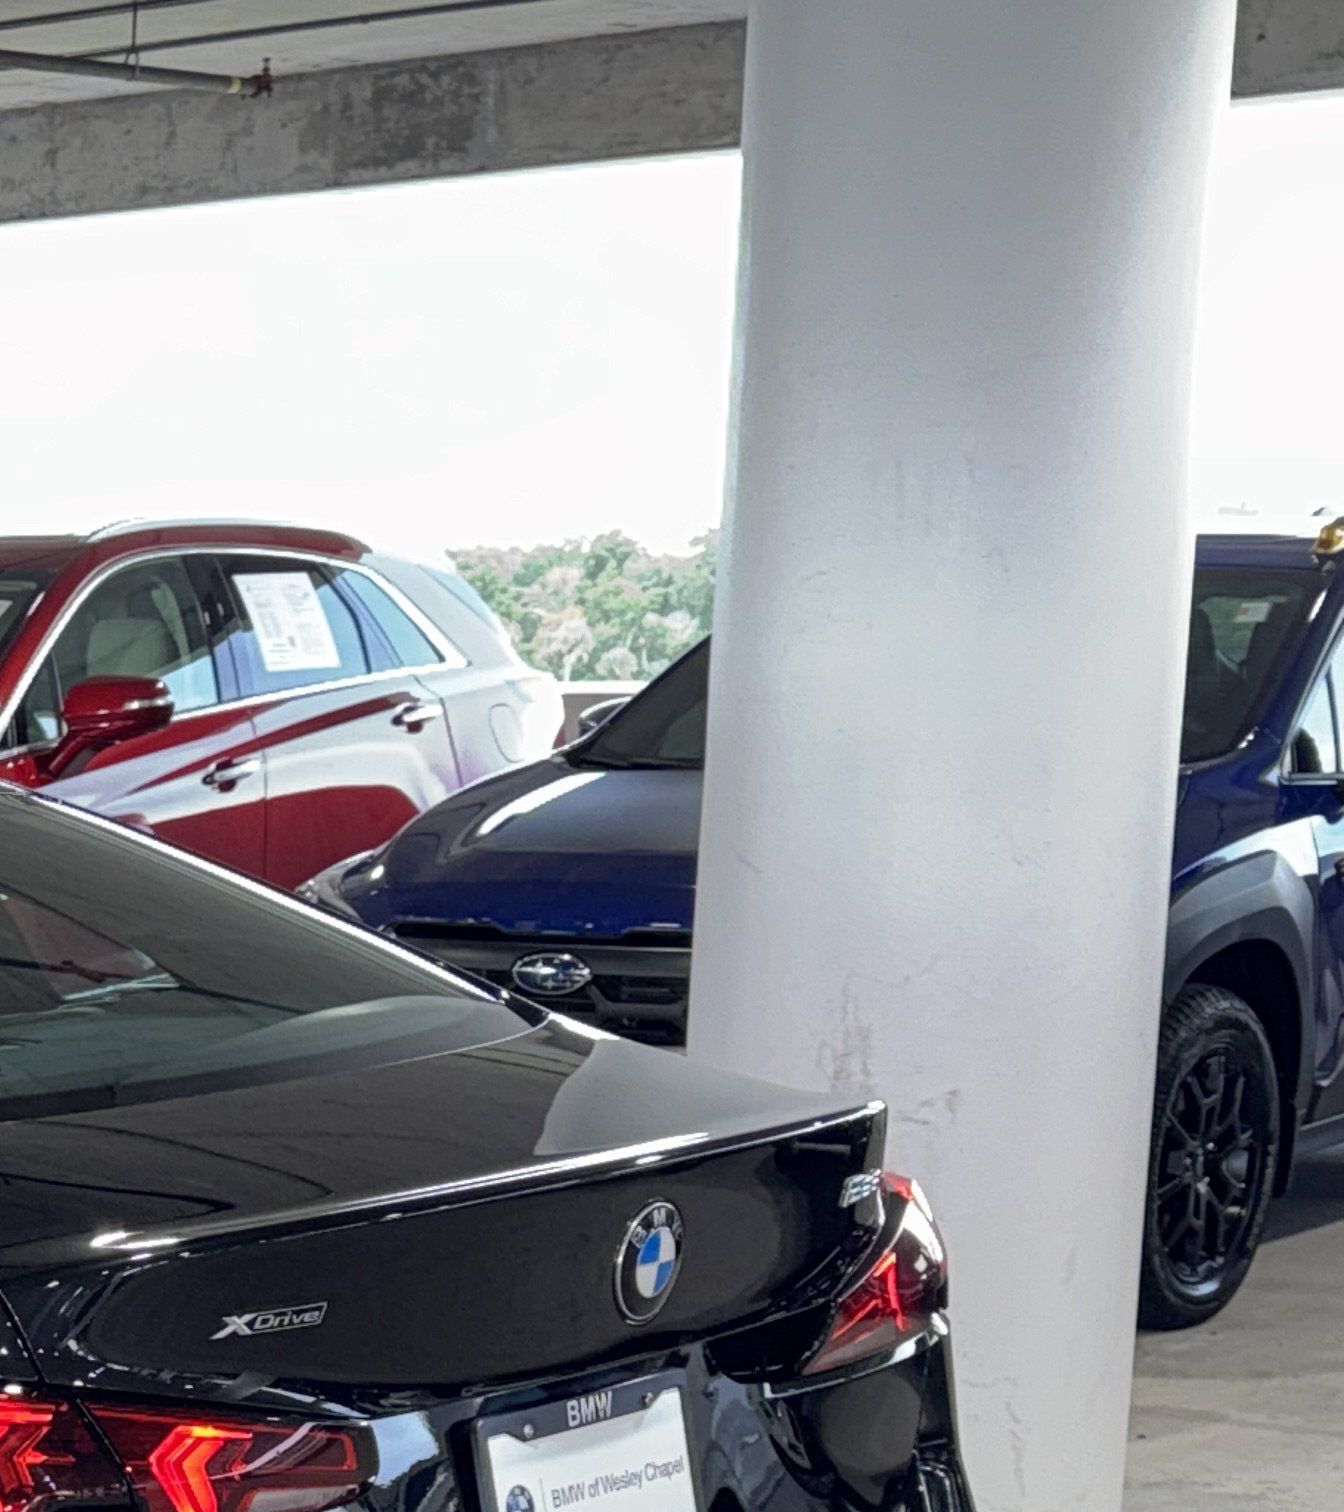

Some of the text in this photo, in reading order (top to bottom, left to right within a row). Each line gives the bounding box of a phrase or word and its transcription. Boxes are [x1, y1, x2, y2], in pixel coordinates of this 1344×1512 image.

[566, 1390, 612, 1427] BMW
[551, 1482, 585, 1508] BMW
[588, 1476, 600, 1498] of
[600, 1469, 643, 1494] Wesley
[644, 1454, 684, 1481] Chapel
